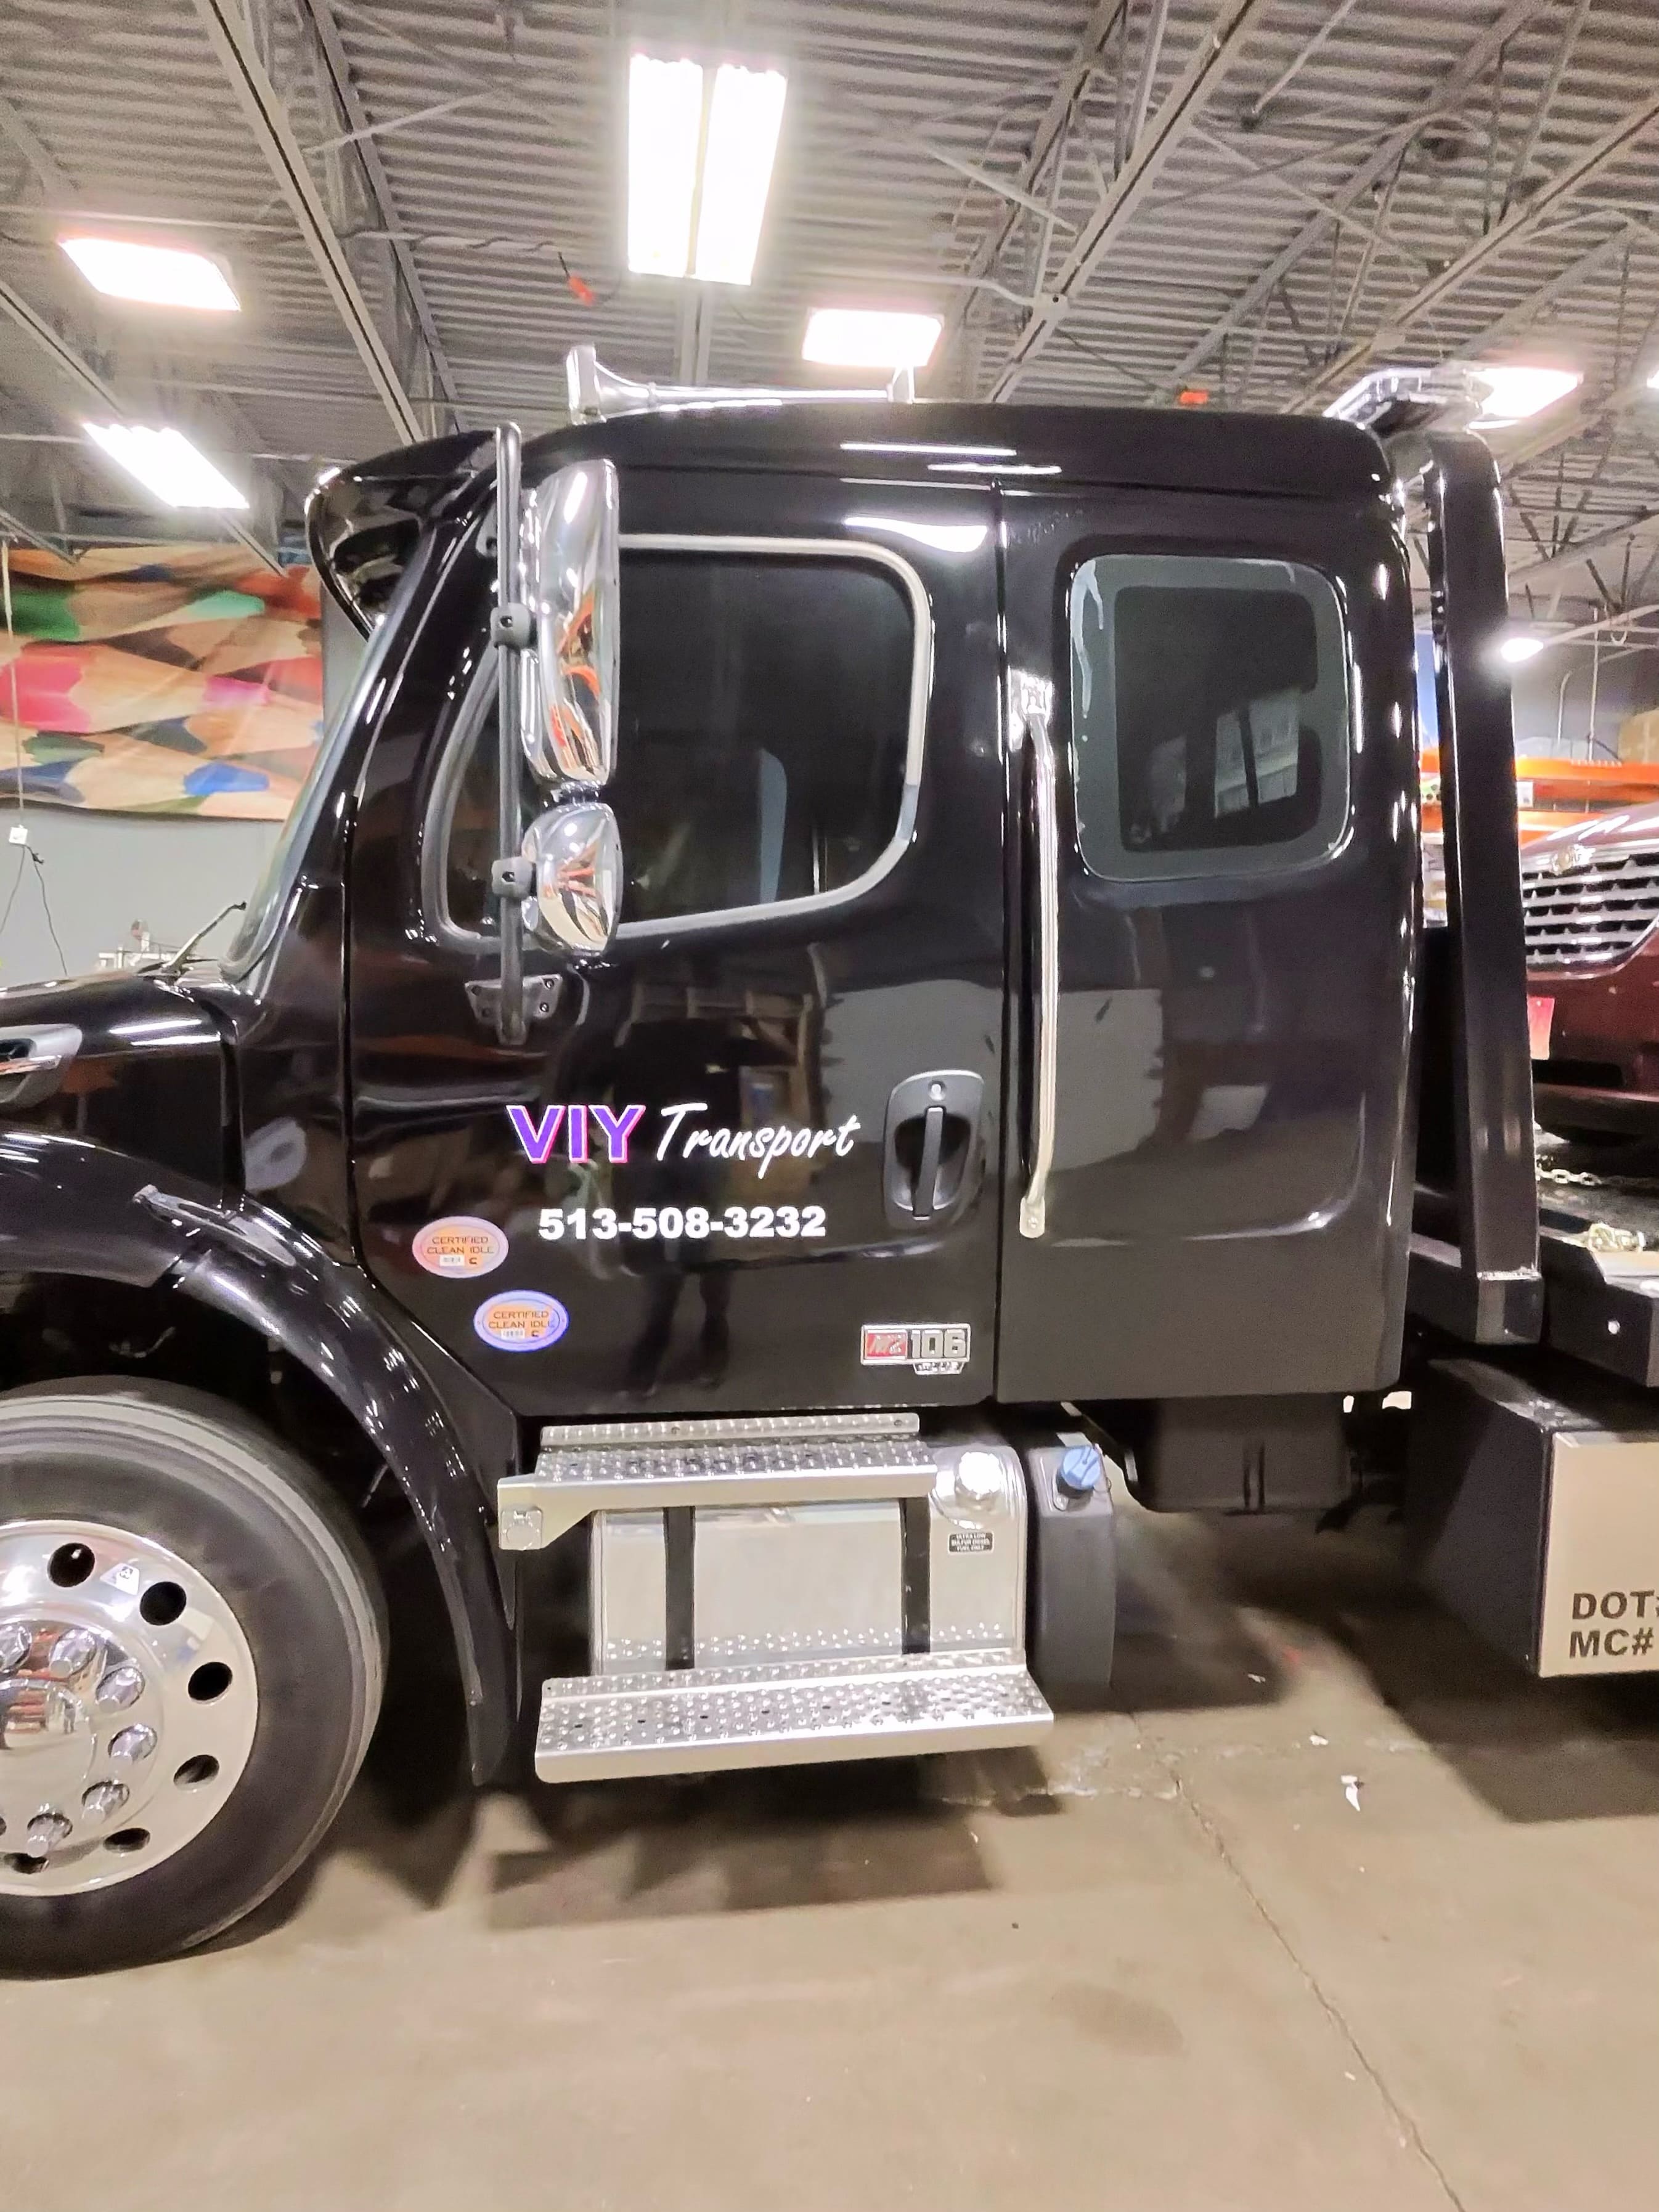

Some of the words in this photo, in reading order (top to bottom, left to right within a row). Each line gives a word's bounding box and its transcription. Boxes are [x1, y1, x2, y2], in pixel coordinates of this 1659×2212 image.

[507, 1105, 646, 1163] VIY
[656, 1102, 861, 1179] Transport
[538, 1206, 826, 1240] 513-508-3232
[426, 1246, 464, 1254] CLEAN
[488, 1321, 525, 1329] CLEAN
[493, 1311, 549, 1319] CERTIFIED
[911, 1329, 966, 1359] 106
[1572, 1590, 1659, 1620] DOT
[1569, 1627, 1654, 1659] MC#
